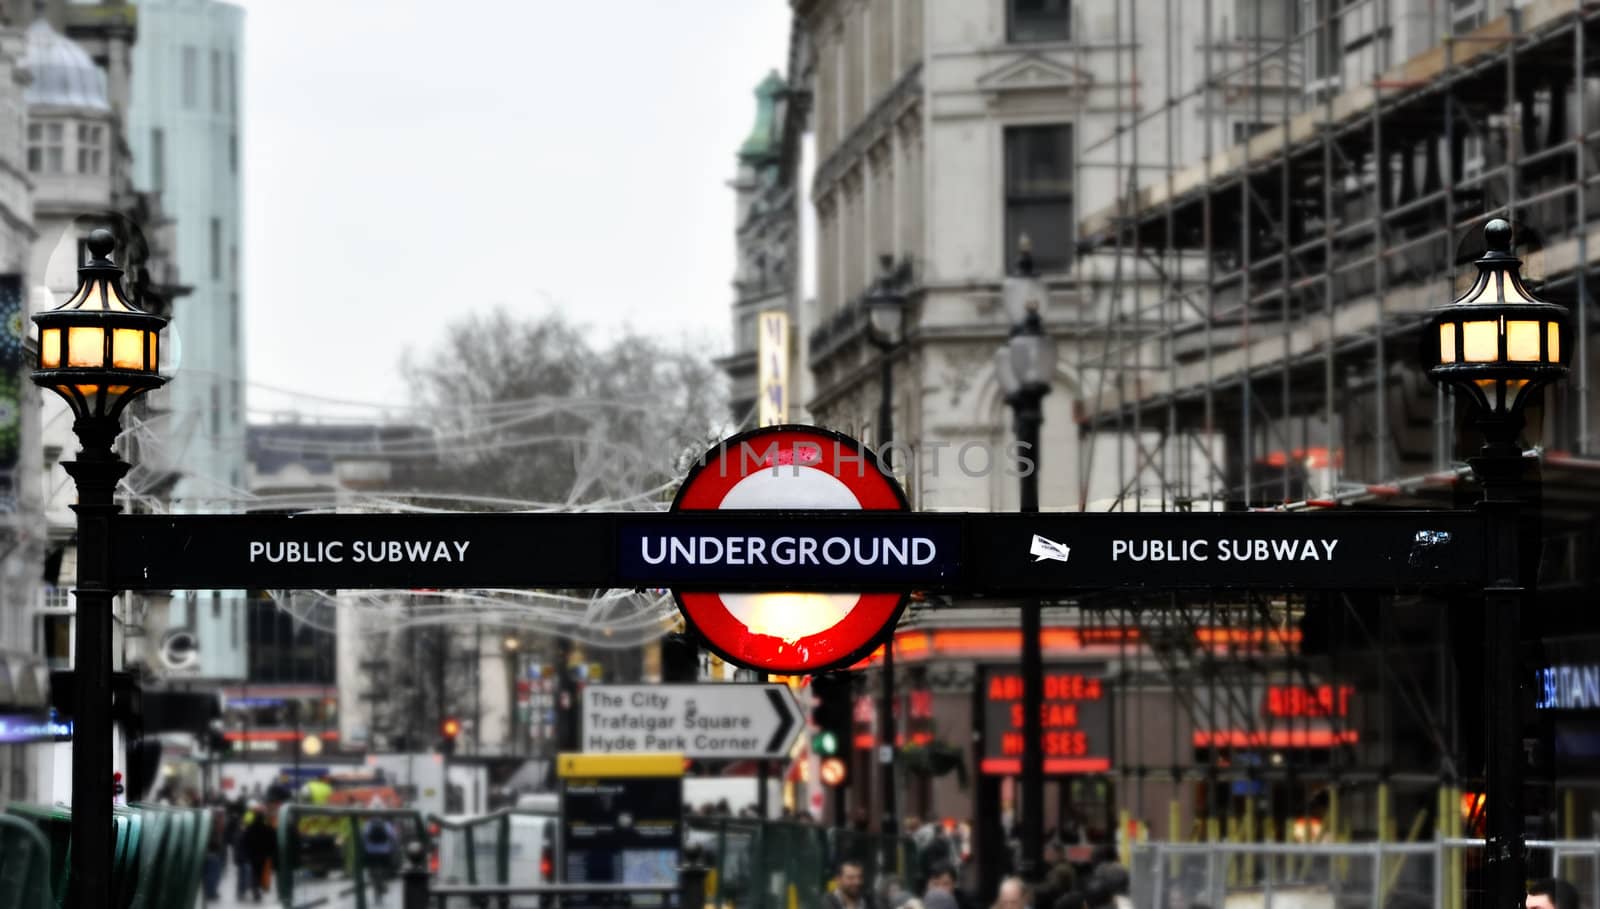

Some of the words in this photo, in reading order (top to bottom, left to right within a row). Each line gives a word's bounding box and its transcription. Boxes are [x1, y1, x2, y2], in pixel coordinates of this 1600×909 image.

[249, 540, 344, 564] PUBLIC
[351, 540, 471, 564] SUBWAY
[640, 536, 937, 567] UNDERGROUND
[1111, 538, 1208, 562] PUBLIC
[1217, 538, 1339, 562] SUBWAY
[590, 691, 623, 707] The
[631, 691, 669, 710] City
[590, 713, 676, 731] Trafalgar
[684, 714, 751, 731] Square
[1010, 703, 1077, 727] SEAK
[590, 735, 637, 753] Hyde
[644, 735, 687, 750] Park
[694, 735, 760, 750] Corner
